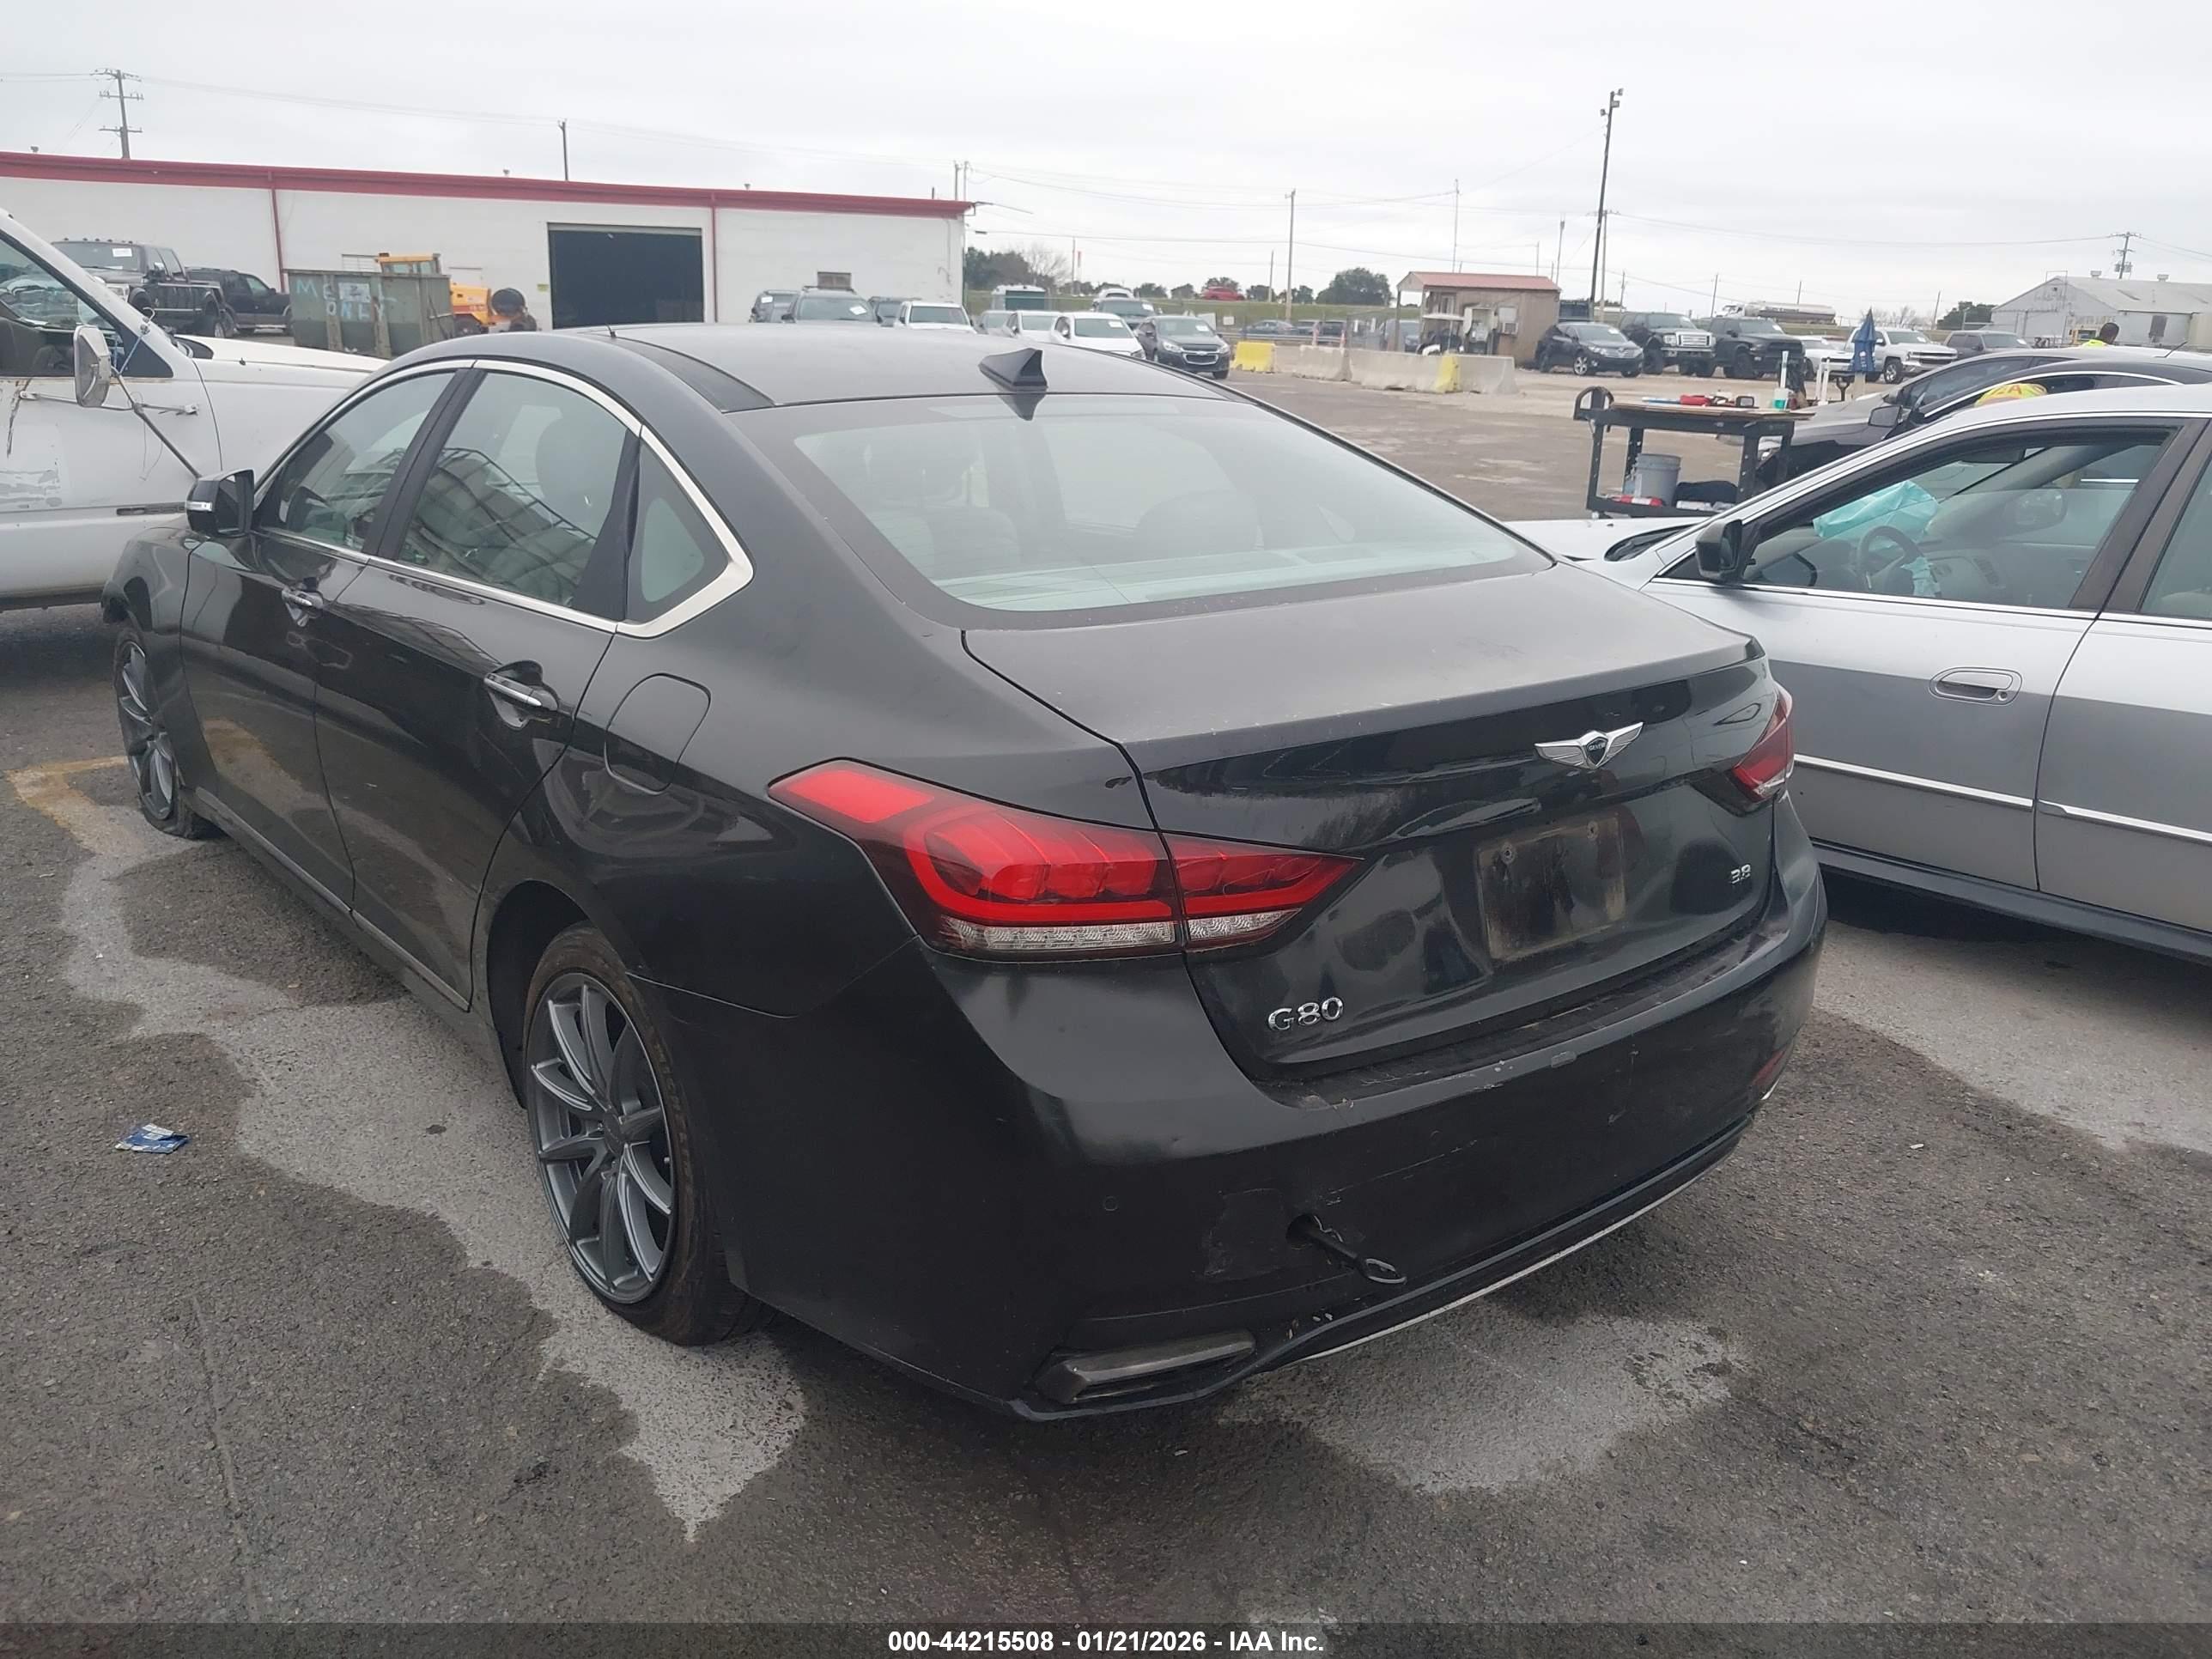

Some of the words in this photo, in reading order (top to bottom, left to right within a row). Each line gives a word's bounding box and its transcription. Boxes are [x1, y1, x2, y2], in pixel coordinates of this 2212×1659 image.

[295, 278, 398, 302] MEL
[326, 301, 385, 320] ONLY
[1268, 997, 1344, 1030] G80
